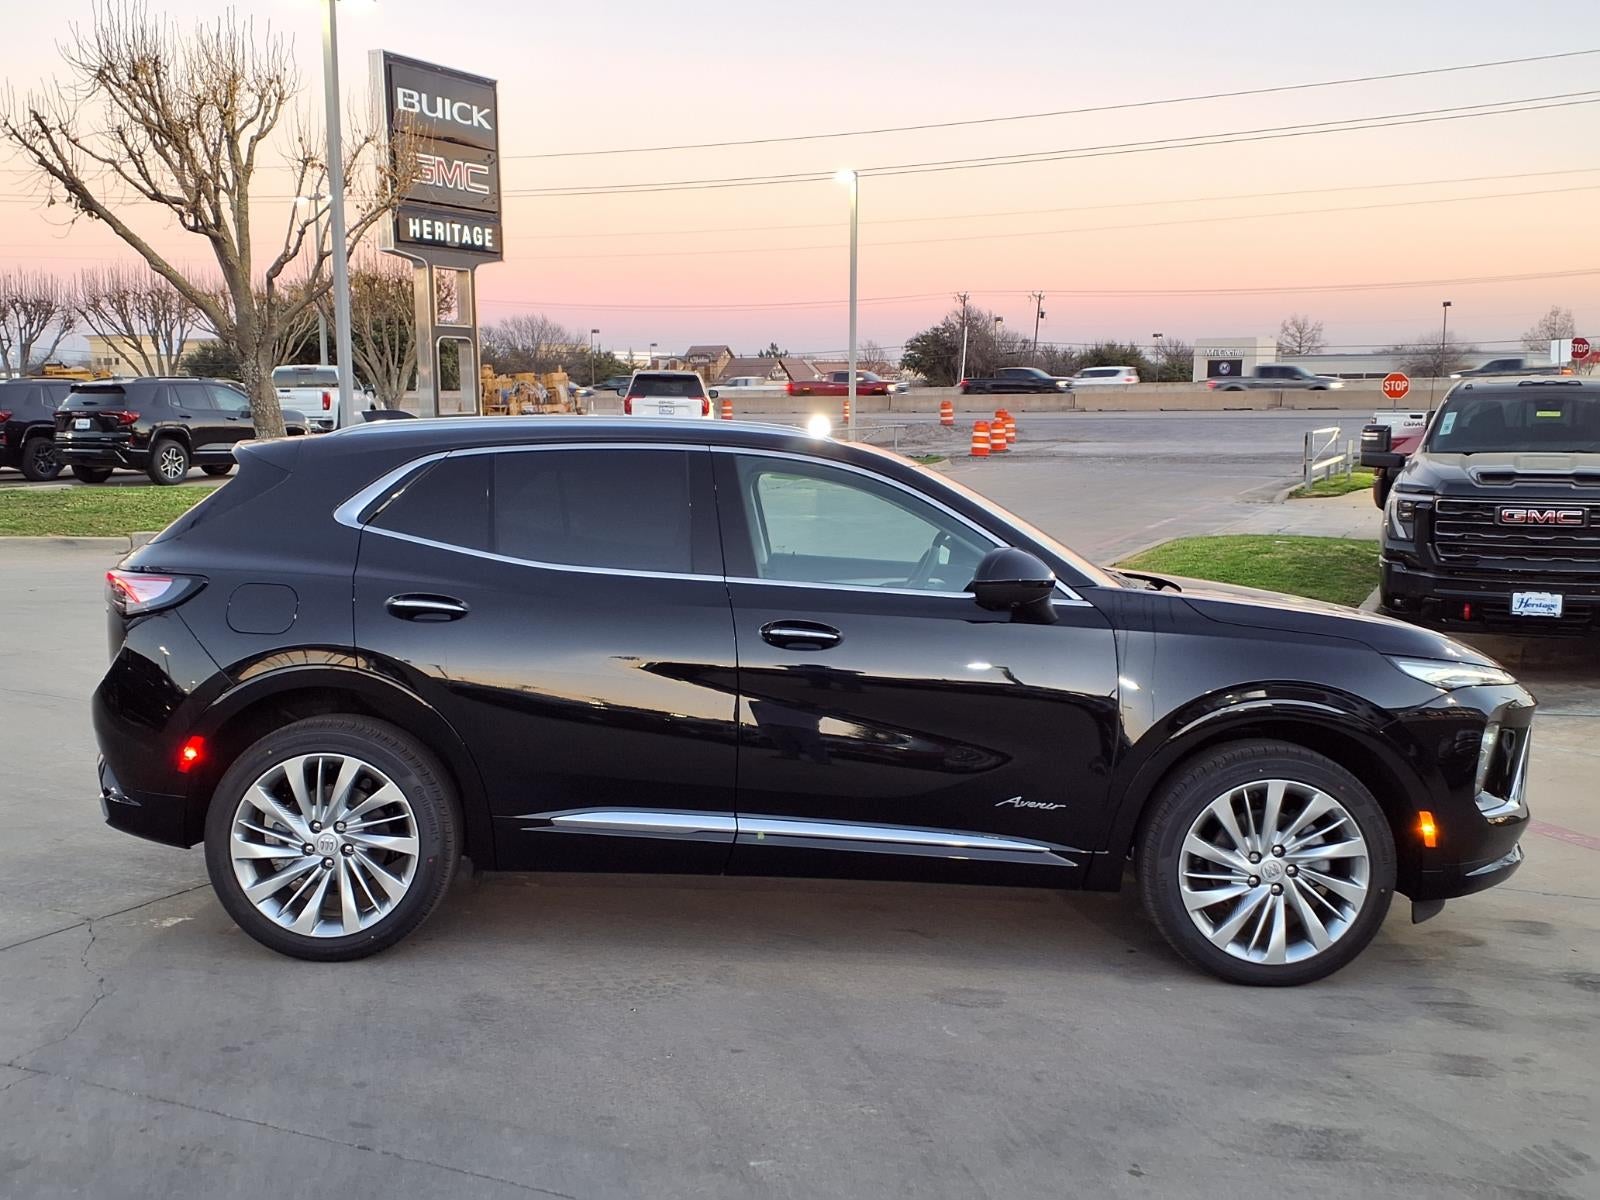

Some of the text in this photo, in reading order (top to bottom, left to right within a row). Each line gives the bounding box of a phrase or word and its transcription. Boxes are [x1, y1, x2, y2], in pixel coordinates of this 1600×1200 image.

[396, 87, 492, 130] BUICK
[411, 153, 490, 195] GMC
[408, 217, 494, 247] HERITAGE
[1384, 380, 1408, 391] STOP
[1502, 509, 1583, 524] GMC
[1514, 597, 1558, 612] Heritage
[994, 796, 1067, 810] Avenir
